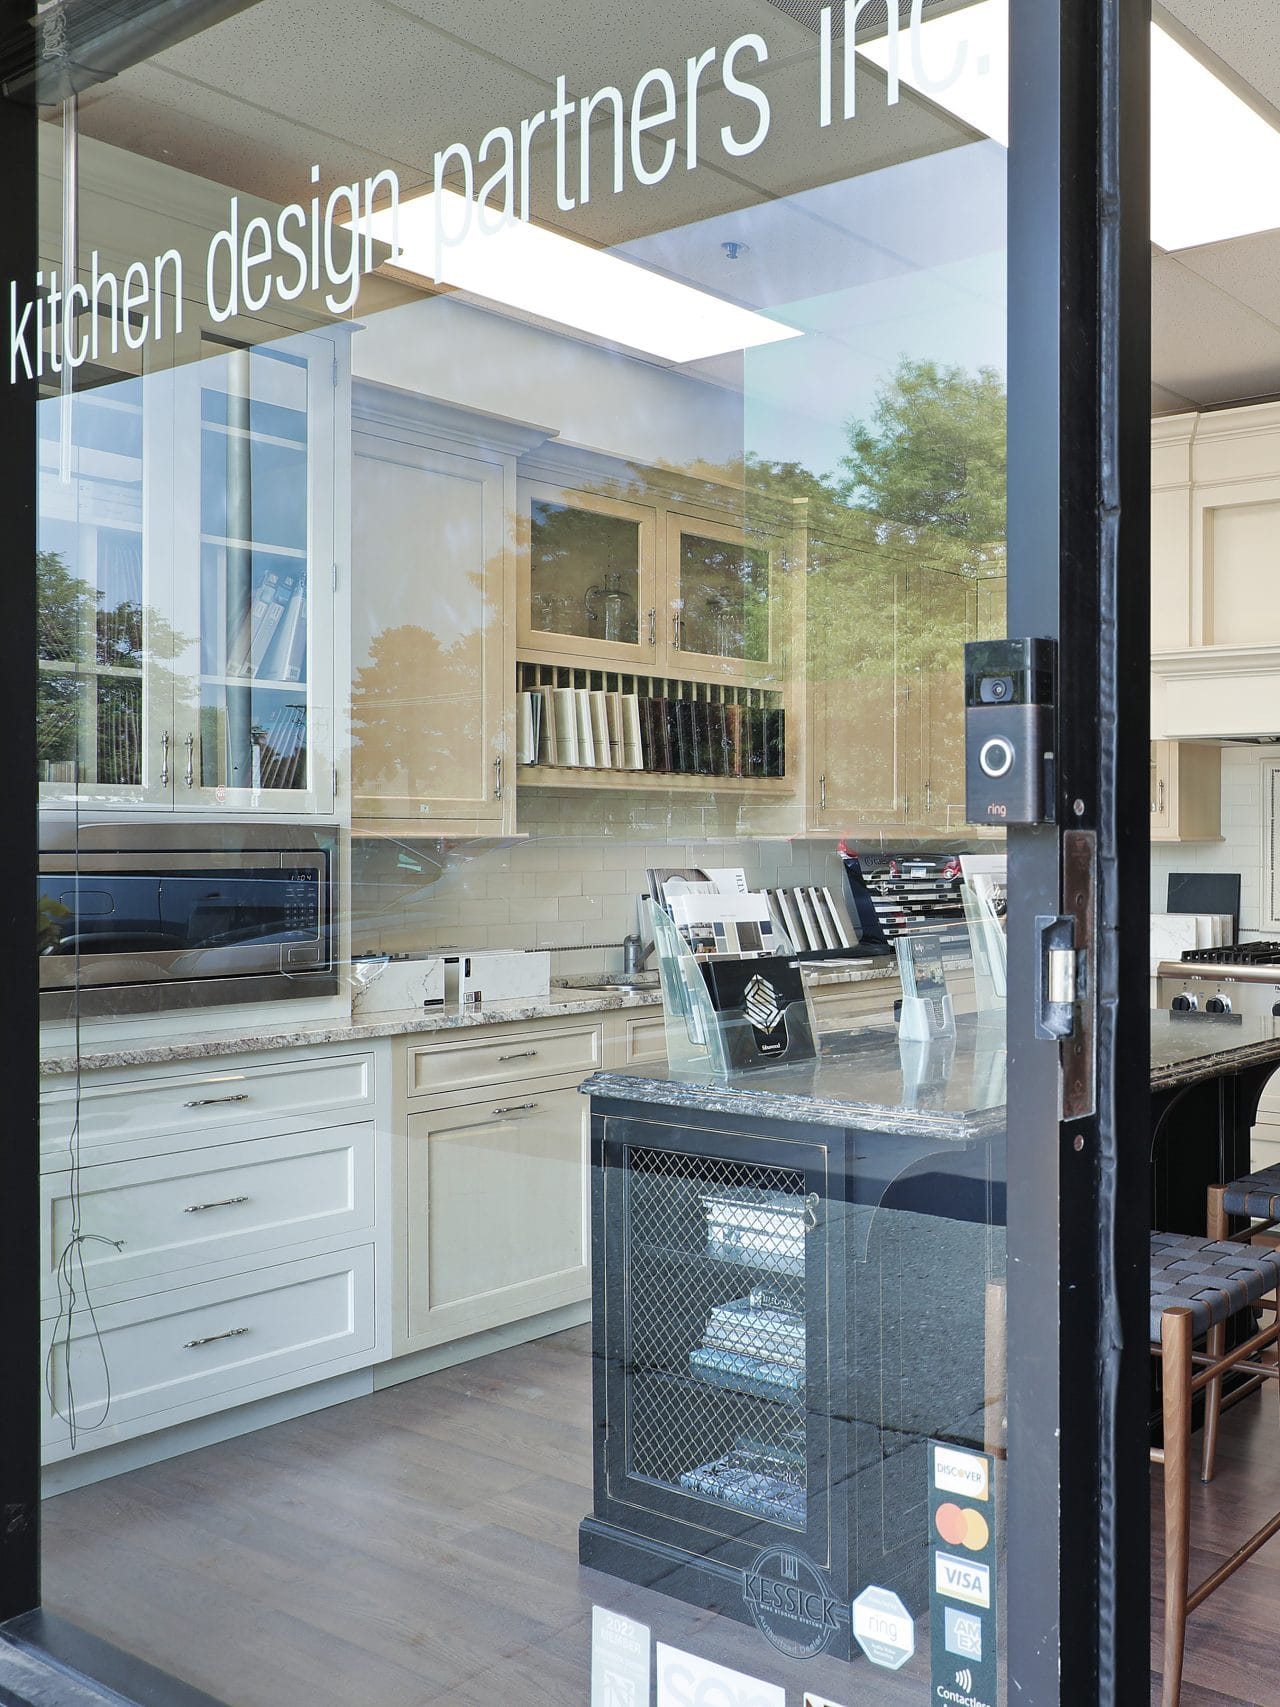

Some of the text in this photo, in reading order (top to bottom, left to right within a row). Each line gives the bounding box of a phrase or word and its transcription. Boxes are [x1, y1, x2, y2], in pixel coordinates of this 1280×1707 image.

[10, 246, 184, 385] kitchen
[205, 164, 401, 322] design
[433, 32, 772, 285] partners
[987, 803, 1007, 818] ring
[937, 1462, 982, 1482] DISCOVER
[944, 1567, 983, 1593] VISA
[744, 1572, 839, 1629] KESSICK
[758, 1615, 823, 1654] Authorized Dealer
[869, 1615, 897, 1641] ring
[953, 1617, 982, 1638] AM
[957, 1631, 982, 1657] EX
[936, 1685, 991, 1707] Contactle
